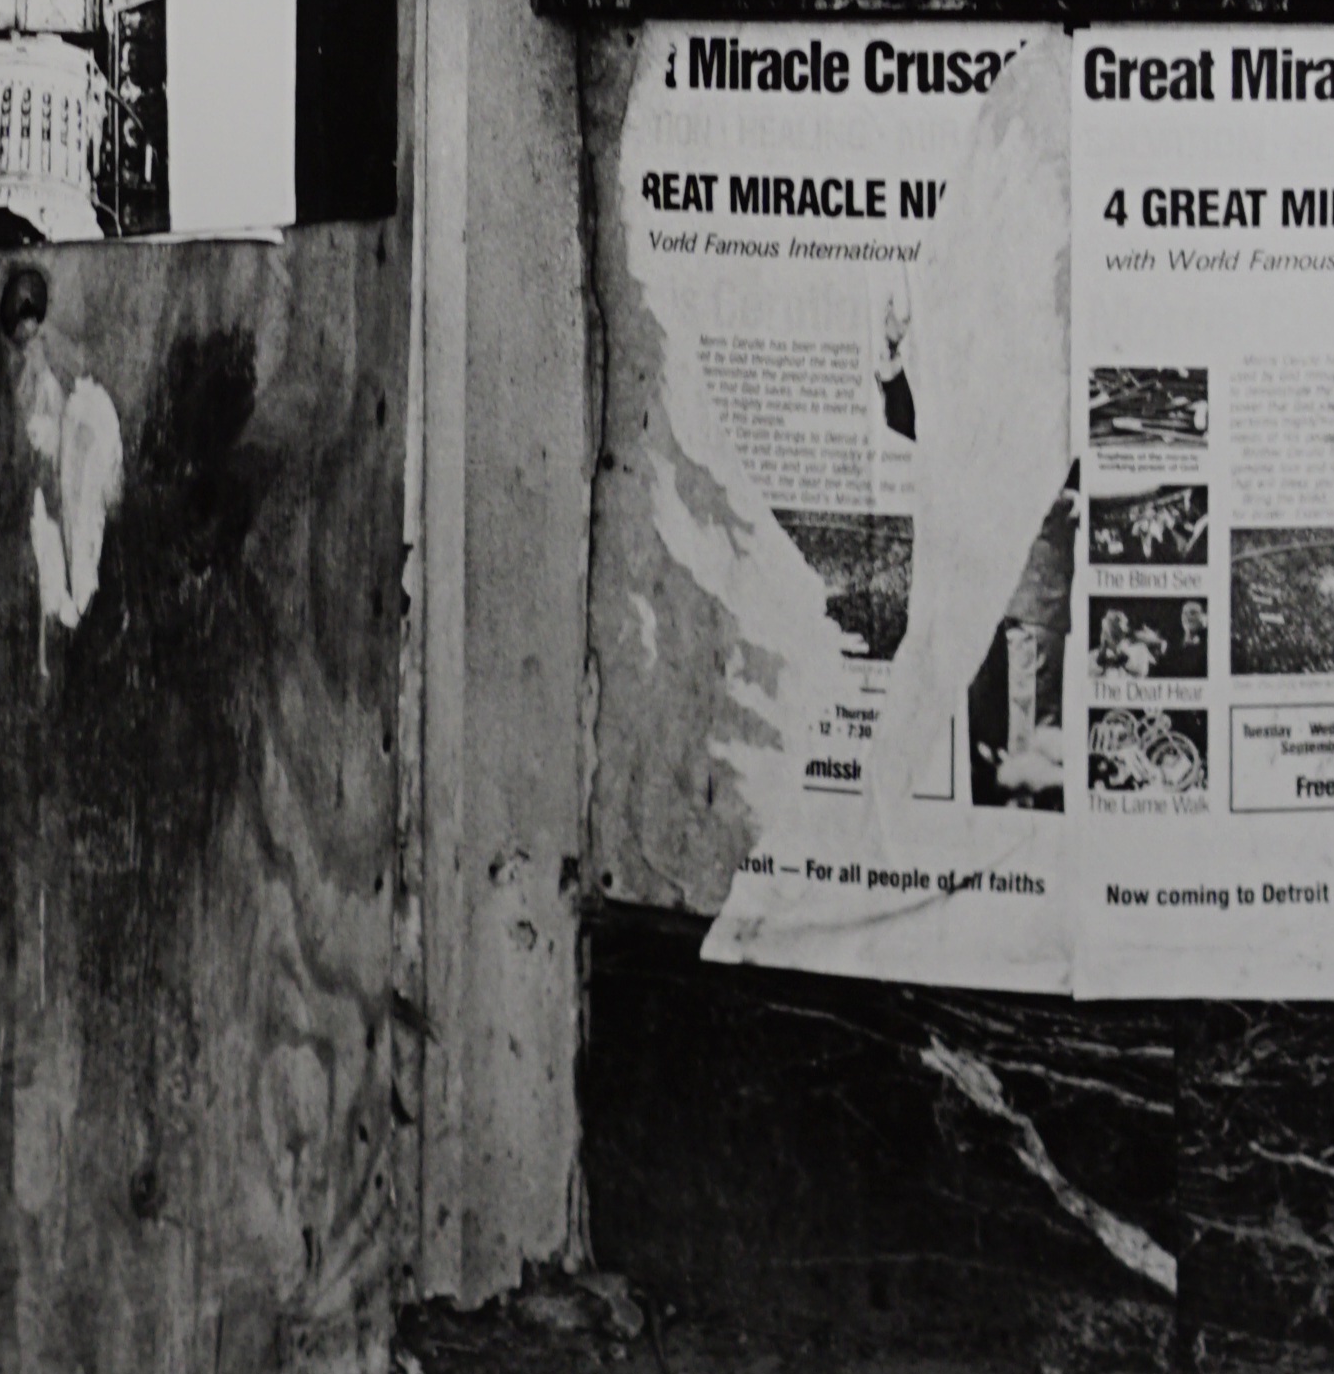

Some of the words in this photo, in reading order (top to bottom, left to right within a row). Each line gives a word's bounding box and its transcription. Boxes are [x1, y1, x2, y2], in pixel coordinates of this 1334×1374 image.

[689, 37, 850, 94] Miracle
[864, 40, 1019, 95] Crusa
[1084, 46, 1215, 101] Great
[729, 174, 887, 218] MIRACLE
[900, 179, 946, 219] NI
[1103, 188, 1128, 227] 4
[1142, 187, 1267, 228] GREAT
[704, 232, 780, 258] Famous
[788, 237, 921, 262] International
[1105, 250, 1155, 271] with
[1167, 249, 1240, 271] World
[1096, 569, 1124, 589] The
[1129, 569, 1167, 589] Blind
[1173, 569, 1202, 589] See
[1092, 680, 1123, 701] The
[1127, 681, 1162, 702] Deaf
[1168, 681, 1203, 702] Hear
[1243, 723, 1292, 738] Tuesday
[806, 755, 861, 780] missi
[1089, 793, 1116, 814] The
[1121, 794, 1166, 815] Lame
[1172, 794, 1210, 816] Walk
[806, 858, 832, 882] For
[839, 864, 860, 884] all
[868, 867, 930, 893] people
[990, 871, 1045, 895] faiths
[1106, 883, 1149, 906] Now
[1157, 883, 1229, 910] coming
[1237, 884, 1255, 904] to
[1262, 881, 1329, 905] Detroit
